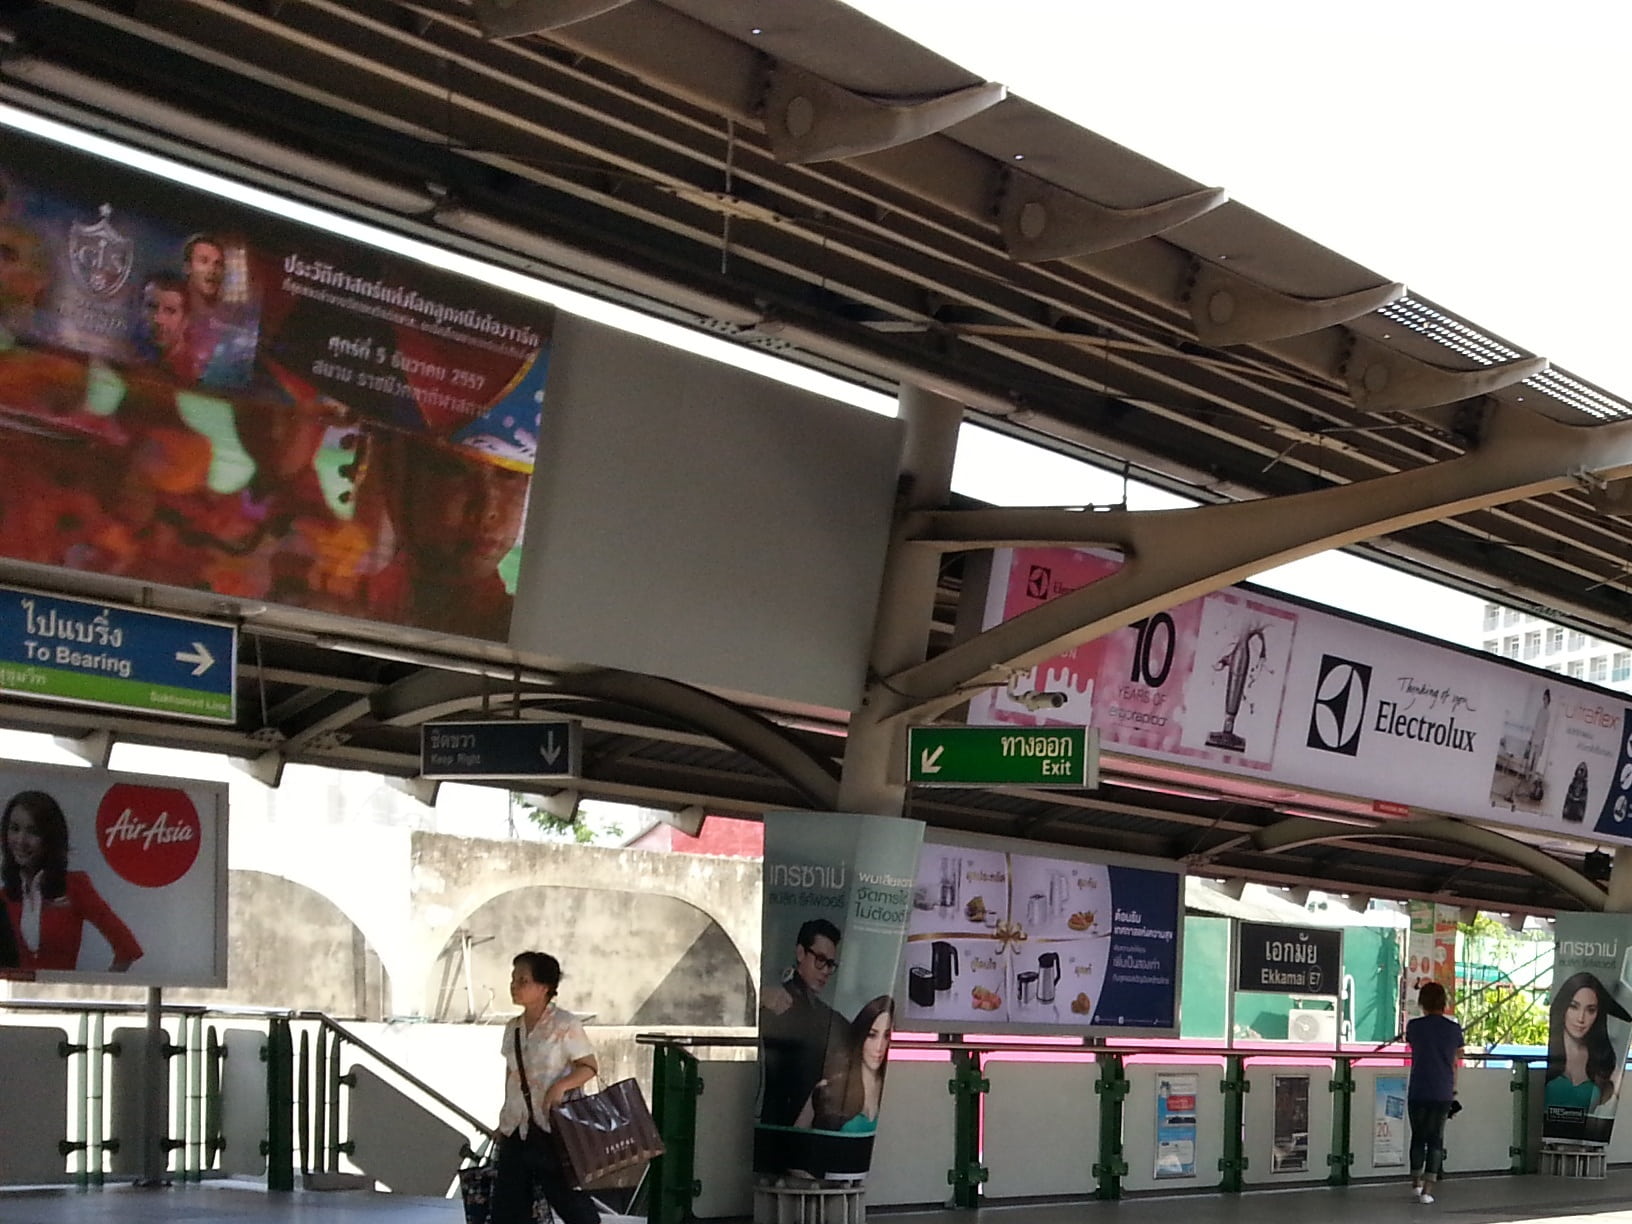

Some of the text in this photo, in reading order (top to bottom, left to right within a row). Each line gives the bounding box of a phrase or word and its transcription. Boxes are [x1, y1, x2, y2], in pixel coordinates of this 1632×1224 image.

[376, 347, 386, 364] 5
[451, 368, 486, 391] 2557
[21, 598, 124, 648] ไปแบริ่ง
[24, 640, 132, 678] To Bearing
[1128, 612, 1176, 688] 10
[1118, 688, 1167, 707] YEARS OF
[1397, 677, 1439, 711] Thinking
[1451, 696, 1477, 713] you
[1374, 700, 1477, 752] Electrolux
[1001, 736, 1073, 757] ทางออก
[1042, 759, 1071, 776] Exit
[105, 808, 193, 850] AirAsia
[768, 860, 845, 889] เทรซาเม่
[1265, 932, 1317, 964] เอกมัย
[1560, 938, 1618, 957] เทรซาเม่
[1261, 968, 1321, 986] Ekkamai E7
